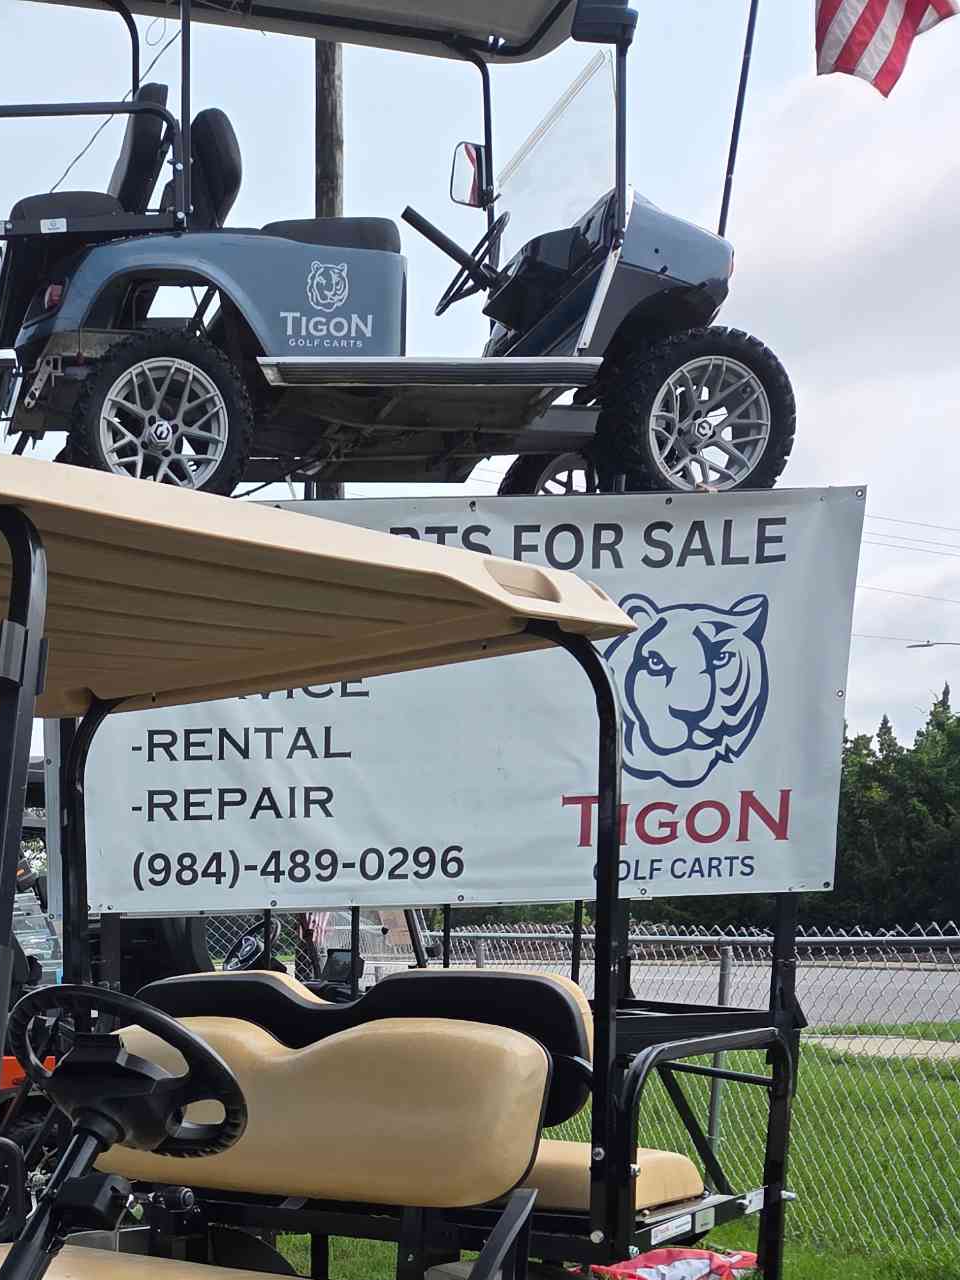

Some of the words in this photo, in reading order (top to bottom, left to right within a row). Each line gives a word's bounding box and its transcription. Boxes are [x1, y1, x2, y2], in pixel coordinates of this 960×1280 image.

[279, 311, 374, 337] TIGON
[288, 338, 322, 347] GOLF
[323, 338, 363, 348] CARTS
[512, 521, 624, 570] FOR
[641, 516, 788, 569] SALE
[131, 726, 352, 763] -RENTAL
[131, 786, 335, 822] -REPAIR
[561, 788, 793, 848] TIGON
[132, 845, 465, 891] (984)-489-0296
[592, 857, 665, 882] OLF
[670, 855, 755, 880] CARTS
